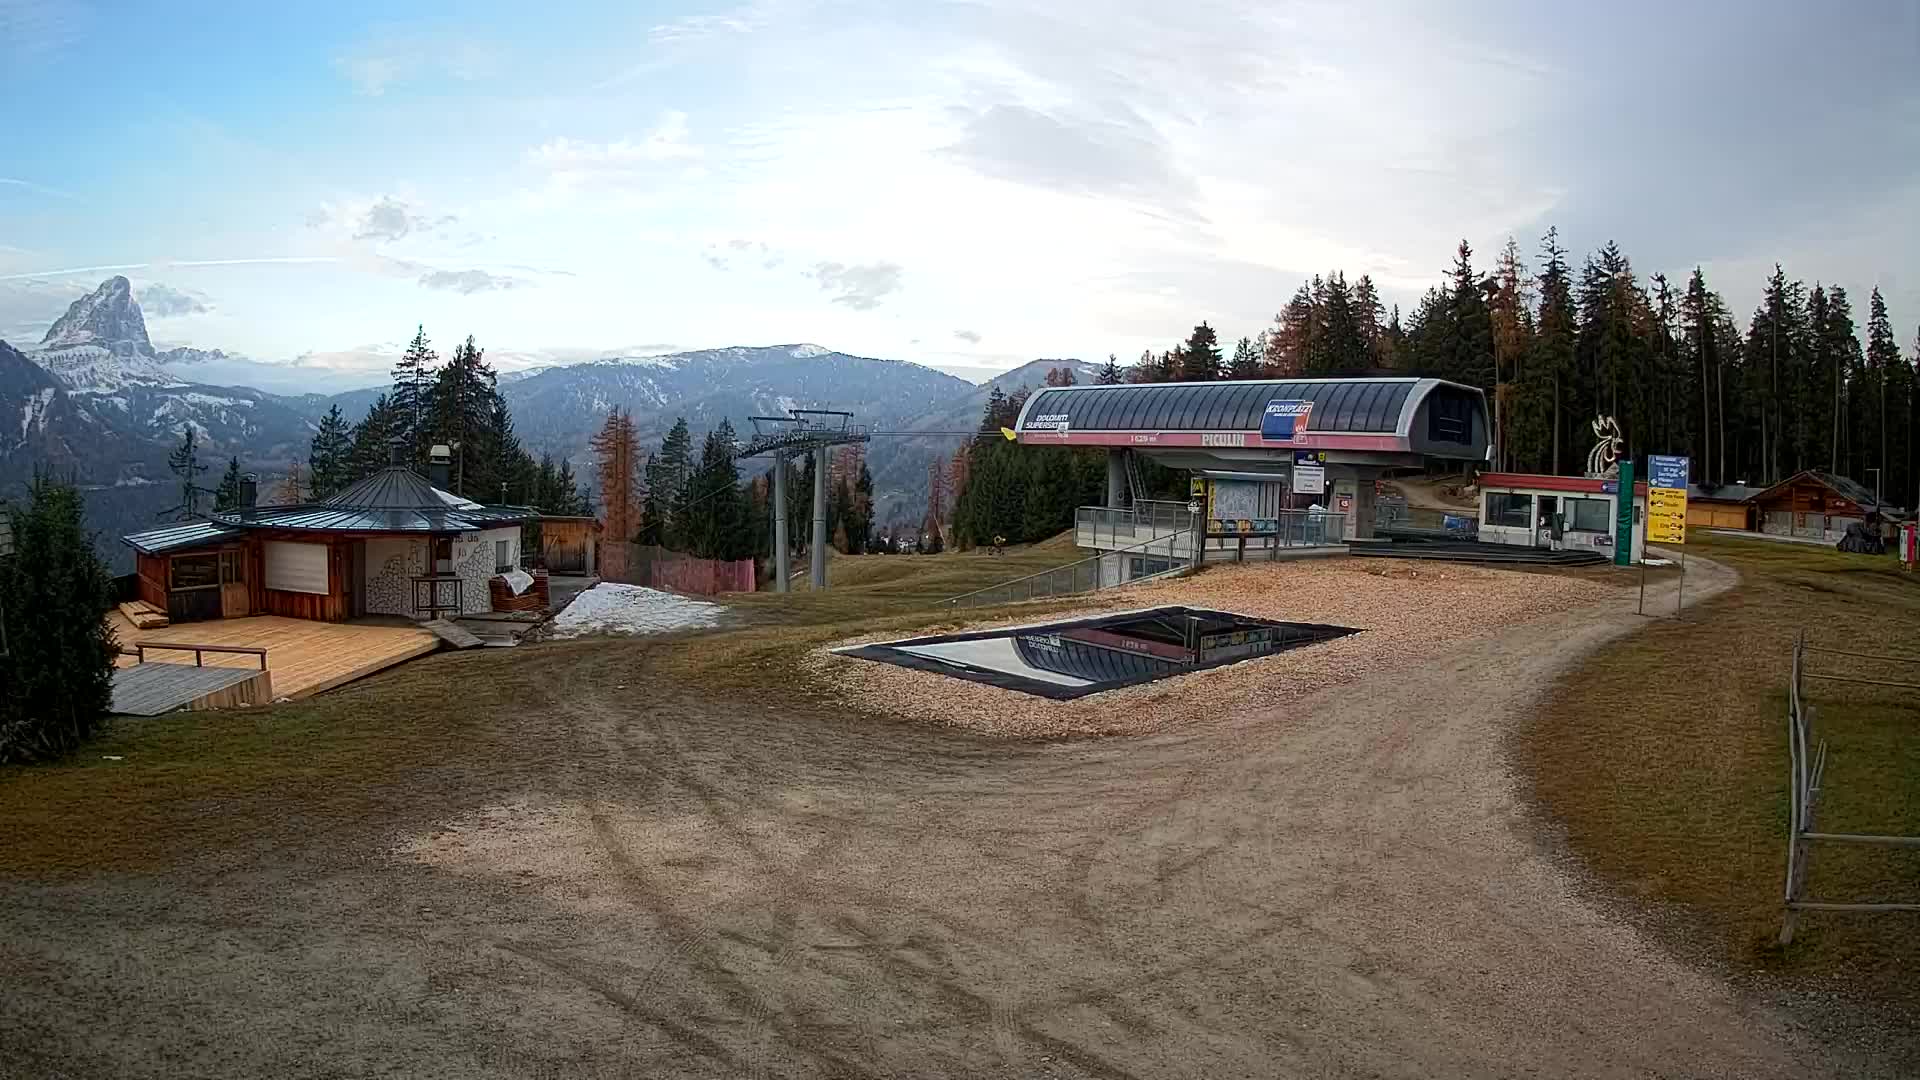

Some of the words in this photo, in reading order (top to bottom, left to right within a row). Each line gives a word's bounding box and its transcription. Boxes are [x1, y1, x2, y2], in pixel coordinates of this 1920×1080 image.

[1036, 414, 1069, 422] DOLOMITI
[1025, 421, 1058, 429] SUPERSKI
[1202, 433, 1245, 447] PICULIN
